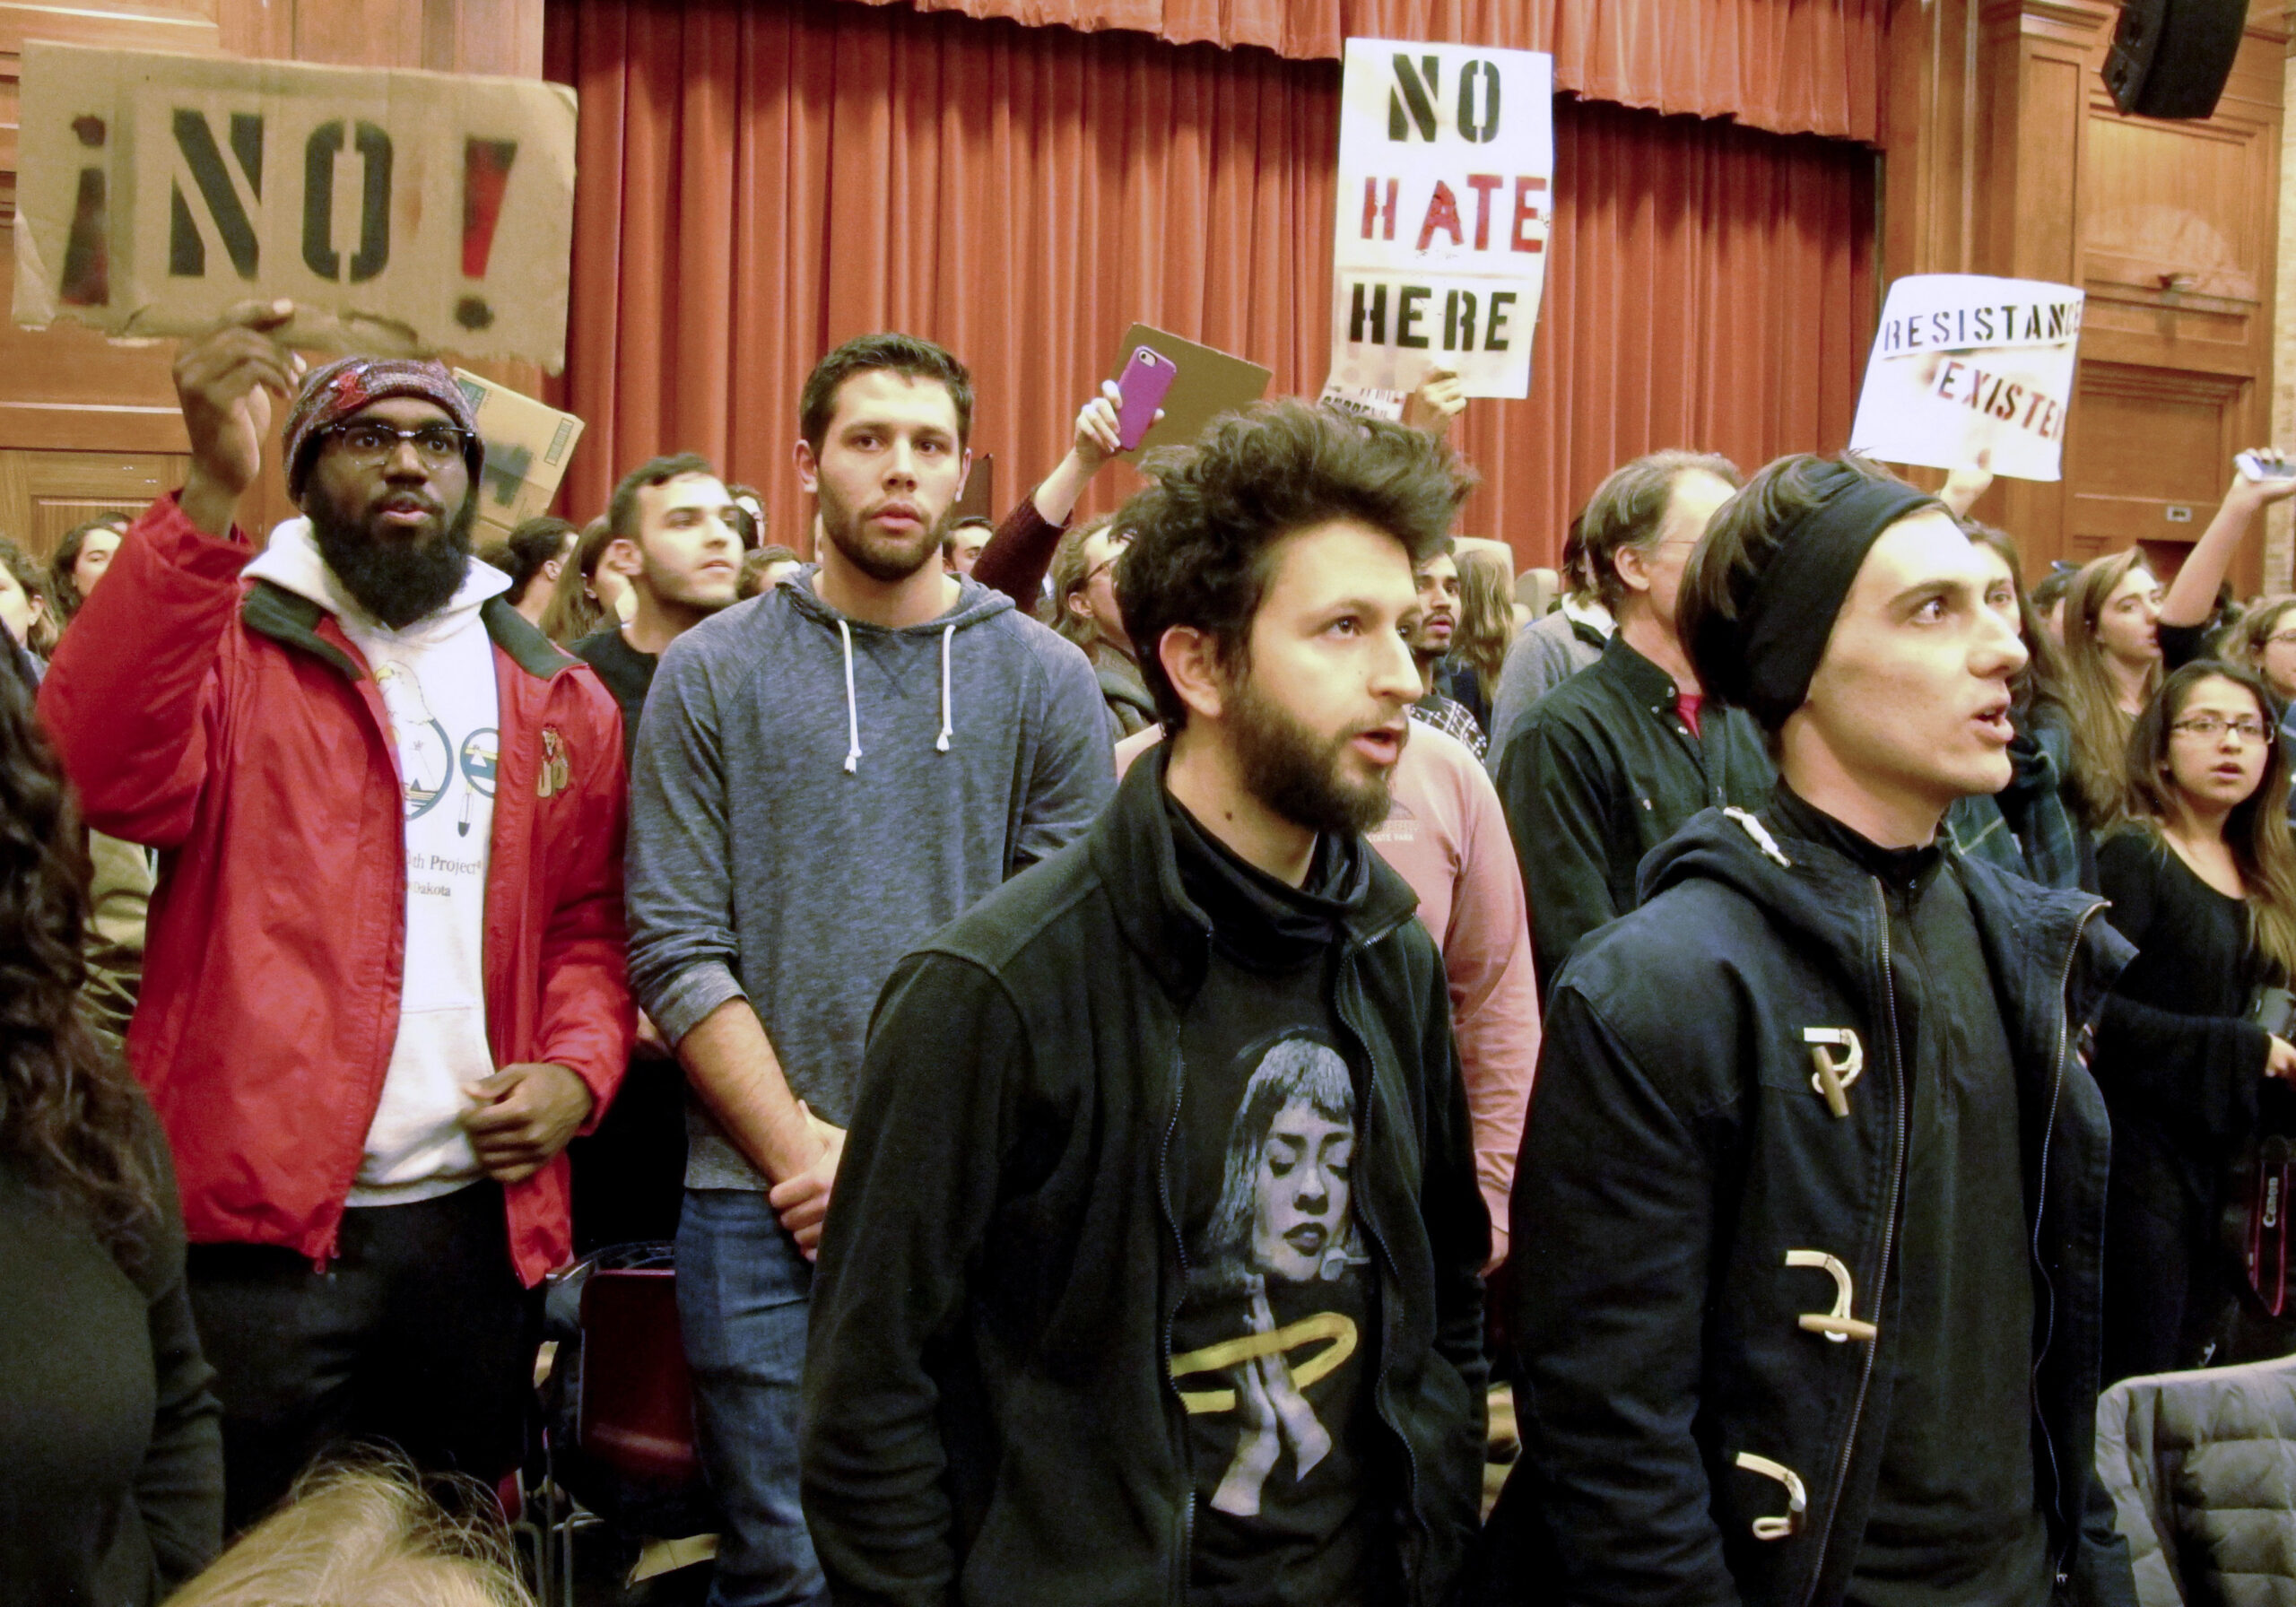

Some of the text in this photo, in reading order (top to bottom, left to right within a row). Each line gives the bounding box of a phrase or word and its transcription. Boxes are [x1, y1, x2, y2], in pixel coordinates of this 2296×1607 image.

[1388, 53, 1501, 143] NO
[1361, 174, 1547, 253] HATE
[1350, 282, 1518, 352] HERE
[2263, 1177, 2278, 1228] Canon
